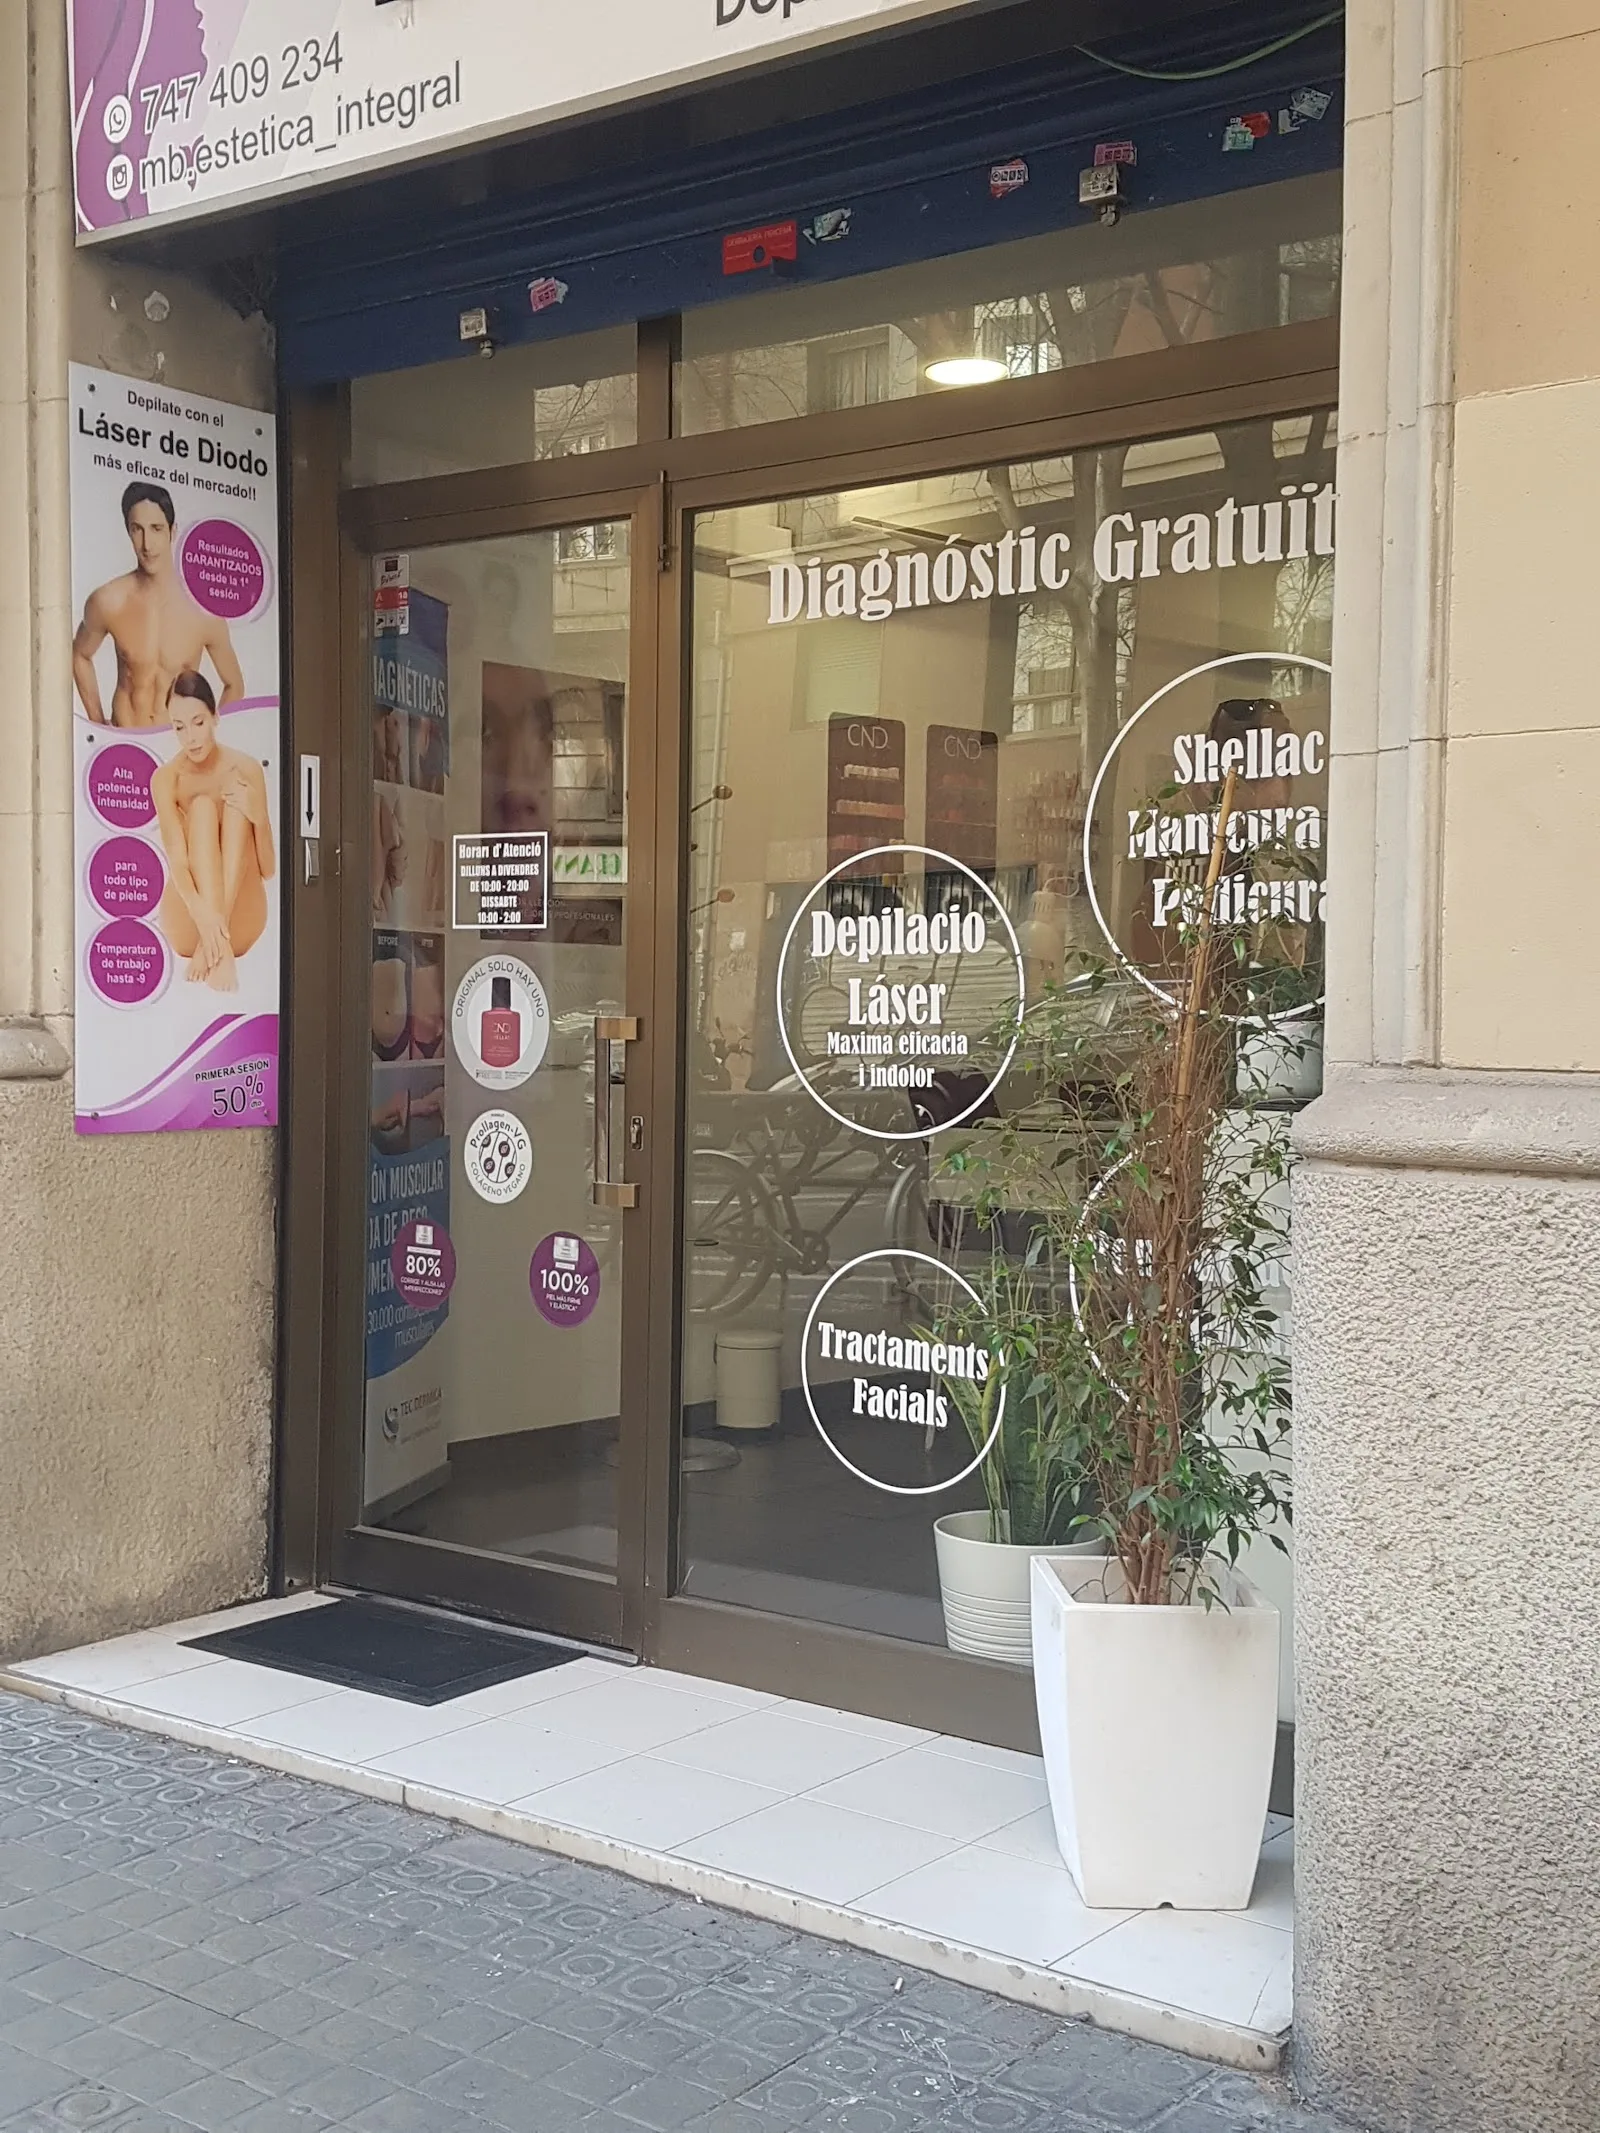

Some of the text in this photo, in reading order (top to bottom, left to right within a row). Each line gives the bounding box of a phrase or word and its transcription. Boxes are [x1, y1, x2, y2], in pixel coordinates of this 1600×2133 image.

[142, 31, 343, 132] 747 409 234
[185, 408, 209, 424] con
[213, 414, 224, 428] el
[78, 408, 268, 477] Láser de Diodo
[93, 453, 257, 501] más eficaz del mercado!!
[198, 539, 249, 560] Resultados
[767, 482, 1338, 625] Diagnóstic Gratuït
[185, 552, 262, 576] GARANTIZADOS
[199, 569, 227, 584] desde
[230, 575, 238, 586] la
[209, 587, 240, 600] sesión
[847, 723, 889, 750] CND
[944, 735, 982, 760] CND
[1173, 727, 1325, 785] Shellac
[113, 767, 133, 780] Alta
[97, 782, 140, 796] potencia
[97, 795, 149, 810] intensidad
[503, 841, 541, 858] Atenció
[115, 861, 137, 872] para
[460, 863, 539, 877] DILLUNS A DIVENDRES
[104, 874, 148, 889] todo tipo
[470, 880, 480, 892] DE
[481, 880, 501, 893] 10:00
[506, 879, 529, 892] 20:00
[104, 889, 148, 903] de pieles
[481, 895, 517, 908] DISSABTE
[477, 911, 498, 924] 10:00
[503, 911, 521, 923] 2:00
[811, 903, 986, 963] Depilacio
[95, 942, 157, 957] Temperatura
[101, 958, 151, 972] de trabajo
[107, 972, 134, 984] hasta
[456, 961, 545, 1018] ORIGINAL SOLO HAY UNO
[848, 974, 947, 1025] Láser
[827, 1030, 968, 1055] Maxima eficacia
[195, 1066, 236, 1082] PRIMERA
[858, 1063, 935, 1088] i indolor
[213, 1073, 264, 1116] 50%
[470, 1120, 526, 1150] Prollagen-VG
[390, 1159, 445, 1200] MUSCULAR
[503, 1163, 526, 1194] VEGANO
[406, 1255, 441, 1278] 80%
[540, 1268, 590, 1296] 100%
[817, 1320, 989, 1381] Tractaments
[852, 1377, 948, 1428] Facials
